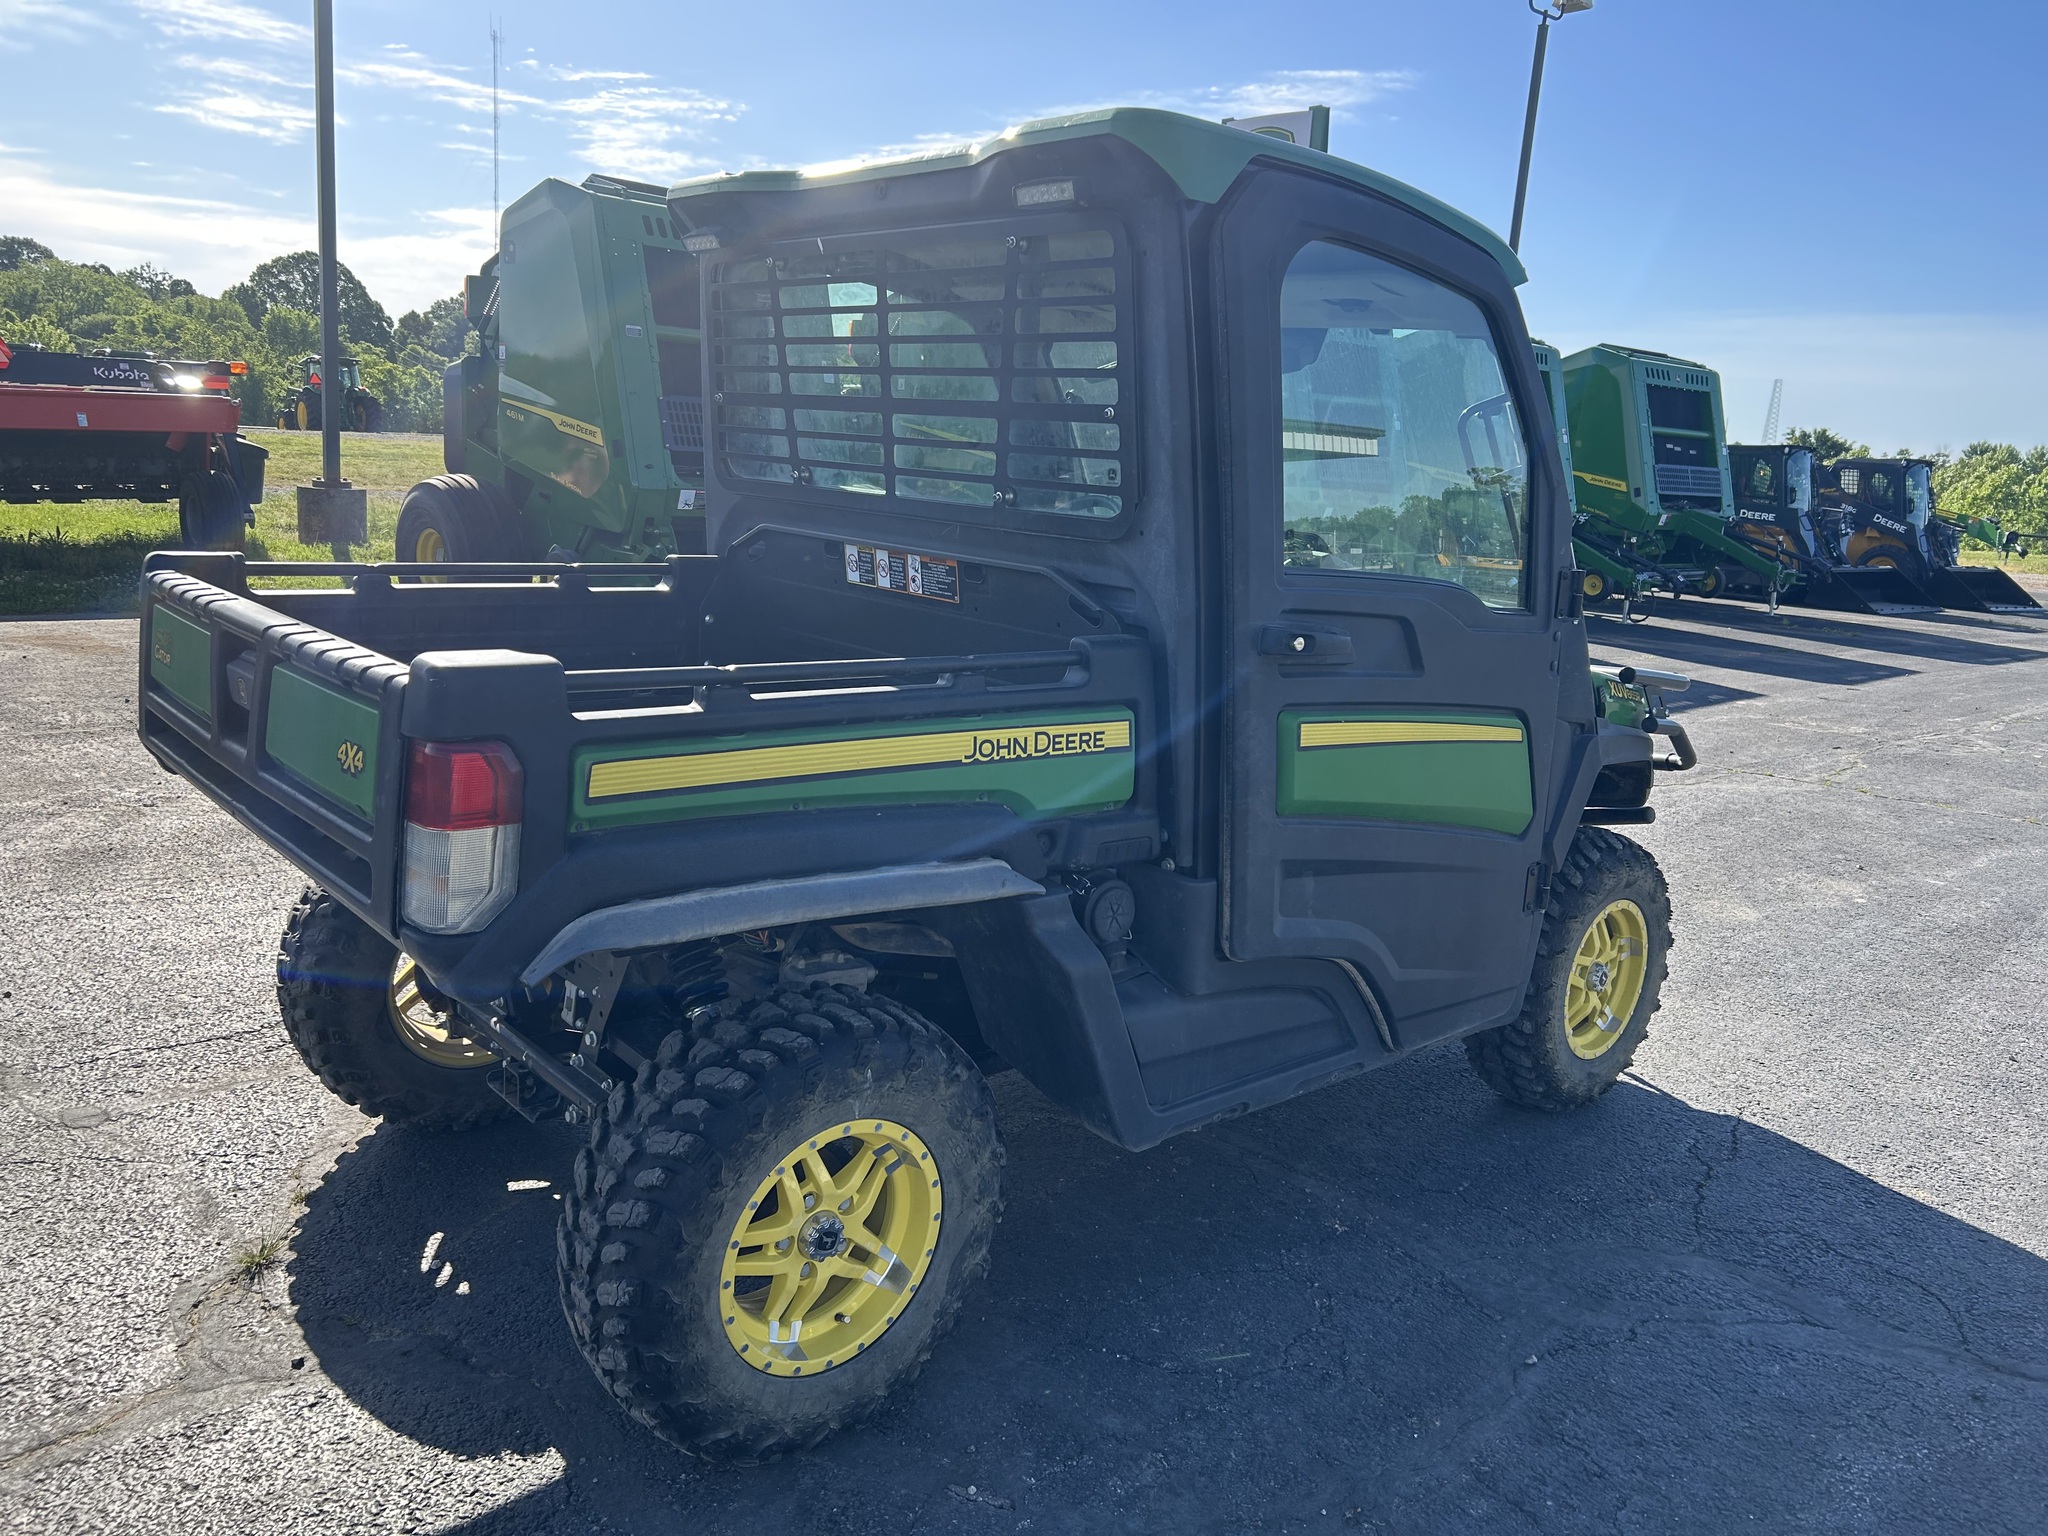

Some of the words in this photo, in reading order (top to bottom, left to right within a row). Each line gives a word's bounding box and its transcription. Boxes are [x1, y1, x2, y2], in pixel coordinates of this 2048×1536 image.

[93, 367, 150, 380] Kubota
[558, 419, 576, 431] JOHN
[576, 424, 598, 439] DEERE
[1604, 480, 1623, 488] DEERE
[1739, 509, 1776, 522] DEERE
[1873, 513, 1908, 534] DEERE
[963, 735, 1028, 761] JOHN
[1033, 731, 1106, 755] DEERE
[336, 740, 364, 773] 4X4
